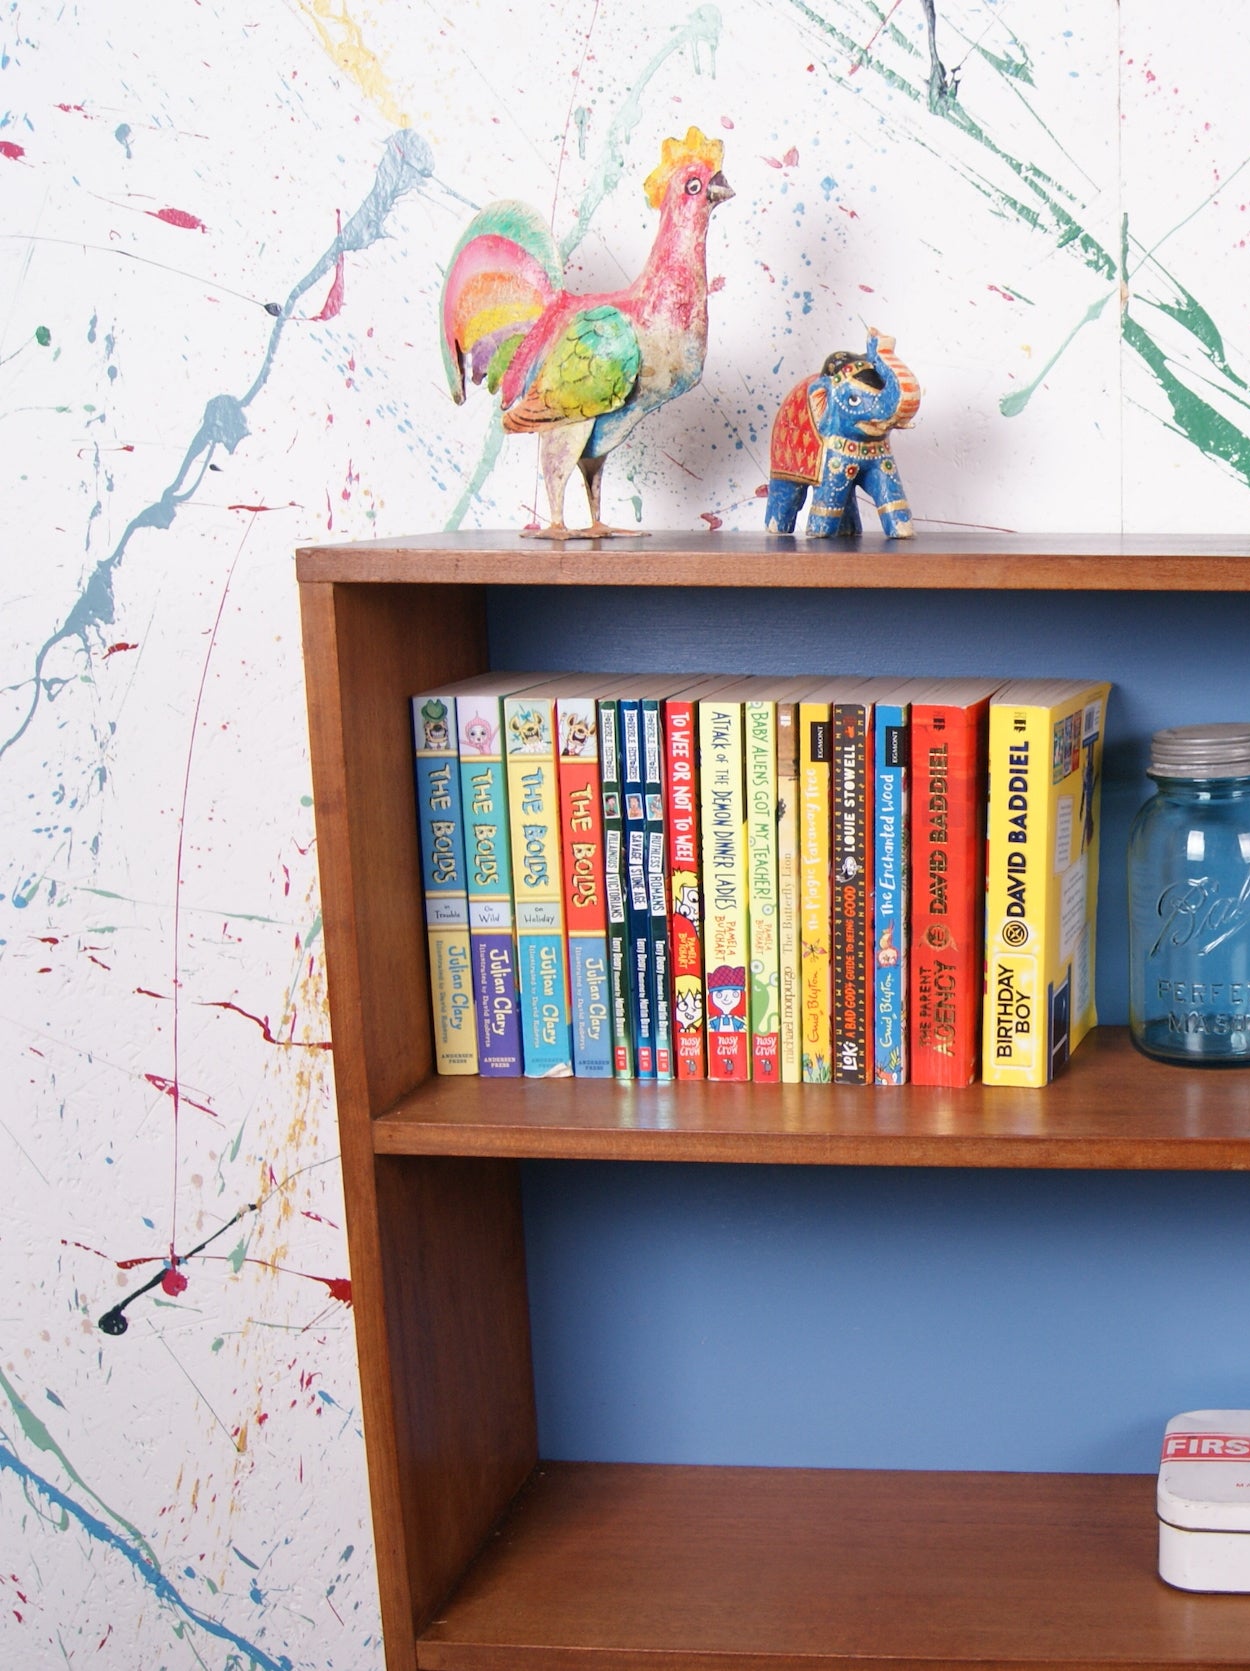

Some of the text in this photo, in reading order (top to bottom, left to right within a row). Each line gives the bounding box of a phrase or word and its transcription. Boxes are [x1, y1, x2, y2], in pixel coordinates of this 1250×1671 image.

[671, 730, 691, 758] WEE
[711, 711, 732, 749] ATTACK
[672, 763, 691, 782] OR
[714, 770, 728, 785] THE
[805, 768, 819, 799] Tree
[672, 787, 692, 812] NOT
[711, 789, 733, 827] DEMON
[751, 712, 773, 899] BABY ALIENS GOT MY TEACHER!
[844, 744, 856, 852] LOUIE STOWELL
[1008, 741, 1029, 844] BADDIEL
[428, 763, 457, 885] THE BOLDS
[471, 767, 499, 886] THE BOLDS
[521, 767, 549, 888] THE BOLDS
[804, 802, 821, 865] Faraway
[928, 742, 948, 915] DAVID BADDIEL
[569, 782, 597, 907] THE BOLDS
[631, 835, 642, 860] SAVAGE
[650, 835, 661, 868] RUTHLESS
[674, 833, 695, 863] WEE!
[713, 831, 736, 868] DINNER
[879, 774, 896, 917] The Enchanted Wood
[607, 875, 622, 919] VICTORIANS
[631, 869, 645, 907] STONE AGE
[650, 876, 664, 911] ROMANS
[714, 873, 737, 910] LADIES
[844, 885, 856, 917] GOOD
[1006, 851, 1027, 917] DAVID
[479, 913, 500, 923] Wild
[524, 914, 555, 925] Holiday
[782, 853, 795, 955] The Butterfly Lion
[714, 915, 726, 961] BUTCHART
[726, 920, 736, 956] PAMELA
[763, 923, 772, 951] PAMELA
[845, 919, 855, 941] BEING
[479, 943, 487, 984] Illustrated
[687, 936, 696, 965] PAMELA
[845, 955, 855, 980] GUIDE
[448, 946, 469, 1030] Julian Clary
[489, 949, 512, 1036] Julian Clary
[540, 946, 560, 1044] Julian Clary
[585, 958, 607, 1040] Julian Clary
[919, 966, 932, 1046] THE PARENT
[782, 966, 797, 1064] michael morpurgo
[844, 1009, 856, 1029] BAD
[933, 960, 956, 1057] AGENCY
[997, 964, 1014, 1058] BIRTHDAY
[1015, 991, 1031, 1034] BOY
[680, 1037, 700, 1048] nosy
[717, 1036, 738, 1047] nosy
[755, 1036, 776, 1047] nosy
[845, 1030, 855, 1038] A
